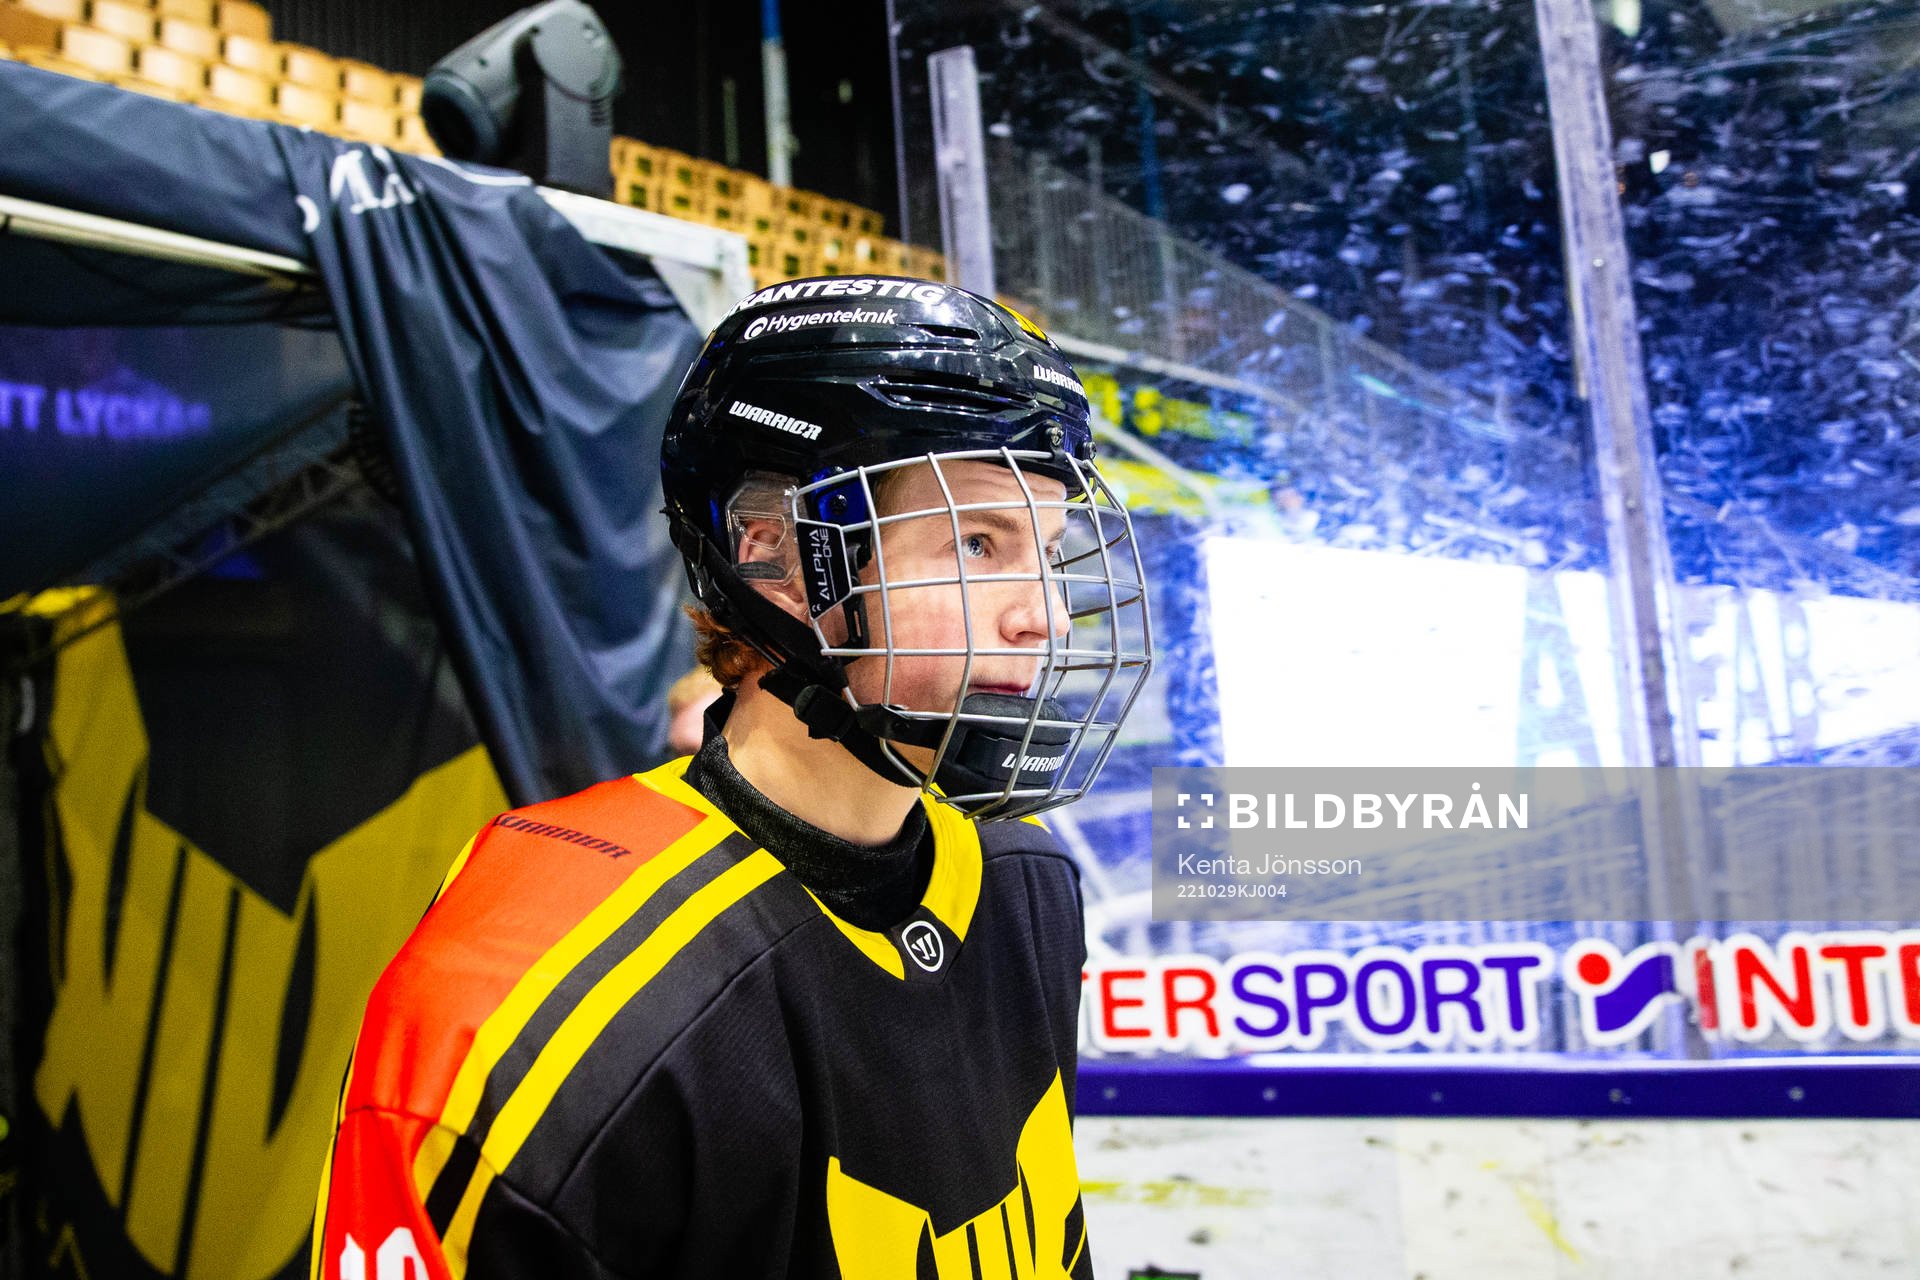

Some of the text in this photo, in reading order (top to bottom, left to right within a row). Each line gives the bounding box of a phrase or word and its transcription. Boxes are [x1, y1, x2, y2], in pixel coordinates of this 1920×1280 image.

[767, 308, 898, 333] Hygienteknik
[729, 400, 823, 441] WARRIOR
[809, 529, 831, 600] ALPHA
[819, 528, 832, 558] ONE
[494, 813, 632, 859] WARRIOR
[1081, 955, 1541, 1039] ERSPORT
